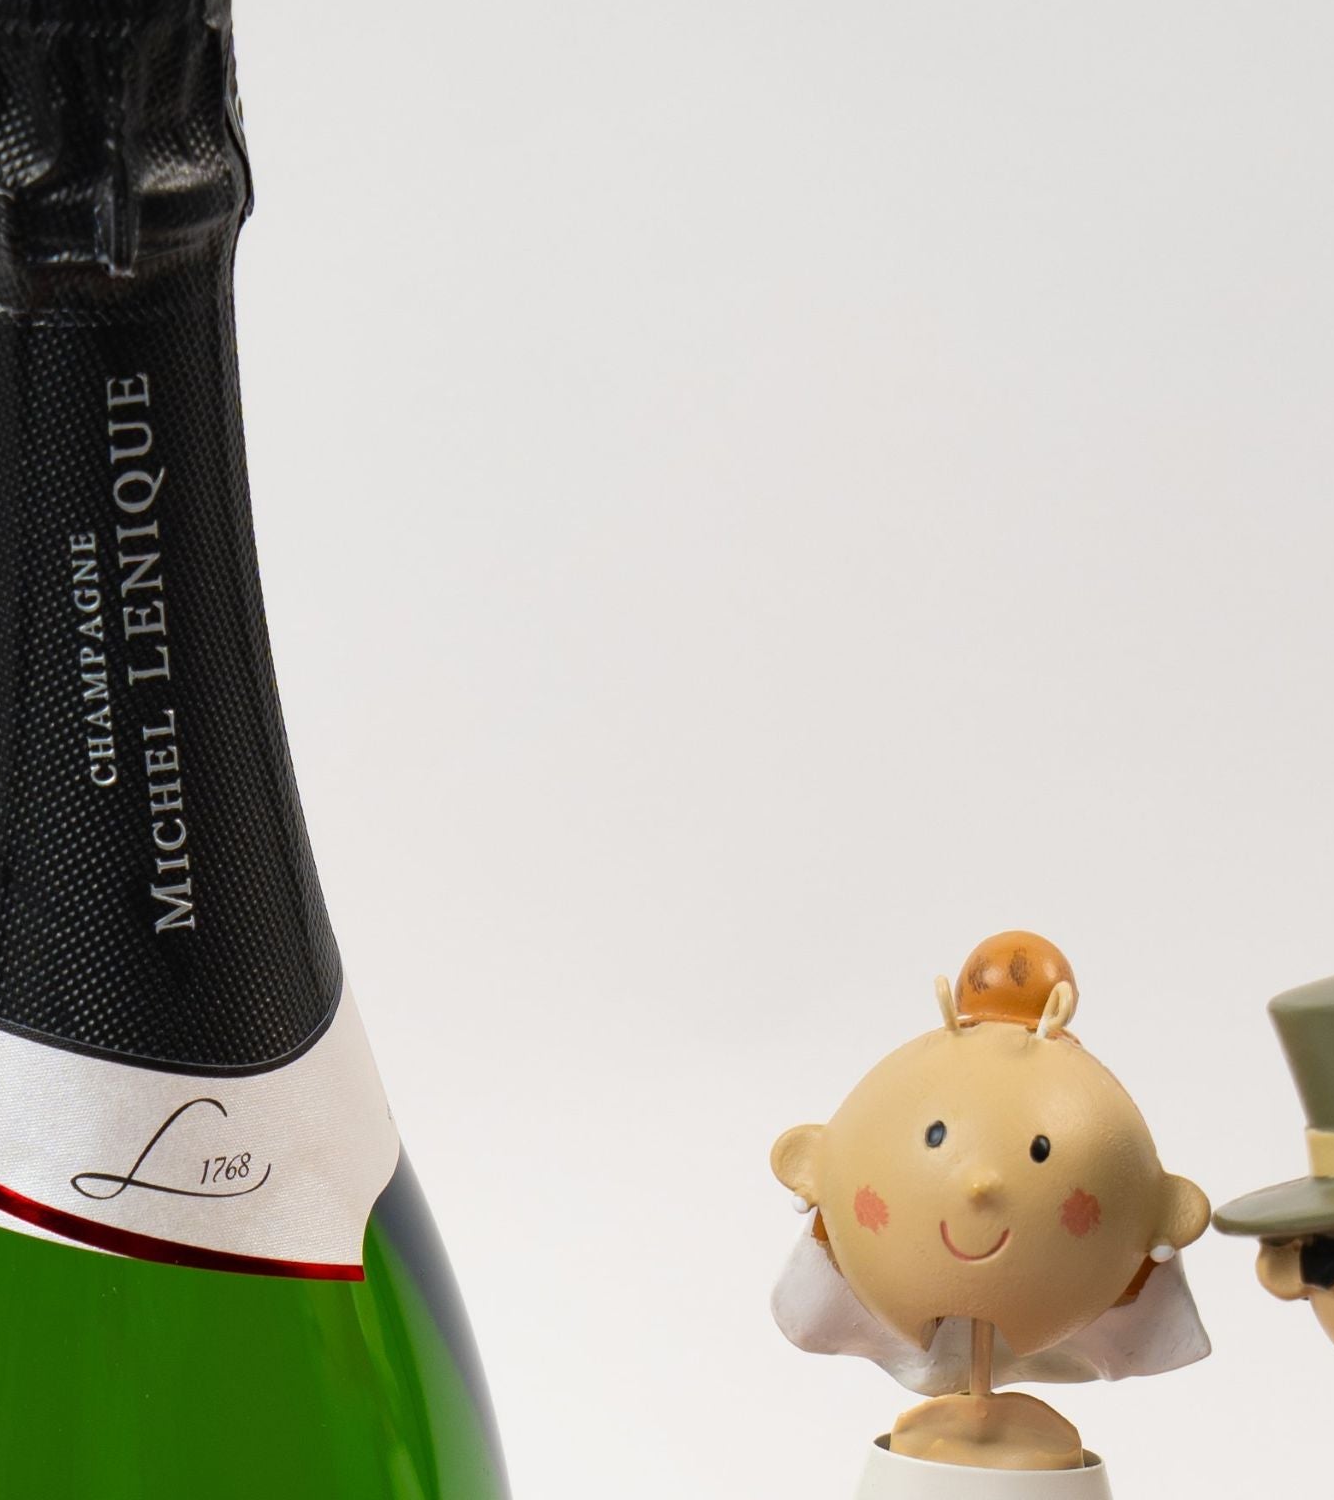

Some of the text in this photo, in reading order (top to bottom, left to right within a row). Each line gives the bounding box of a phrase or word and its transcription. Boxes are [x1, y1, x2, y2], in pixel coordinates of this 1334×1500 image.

[69, 531, 116, 788] CHAMPAGNE
[108, 371, 196, 934] MICHEL LENIQUE
[200, 1152, 252, 1185] 1768
